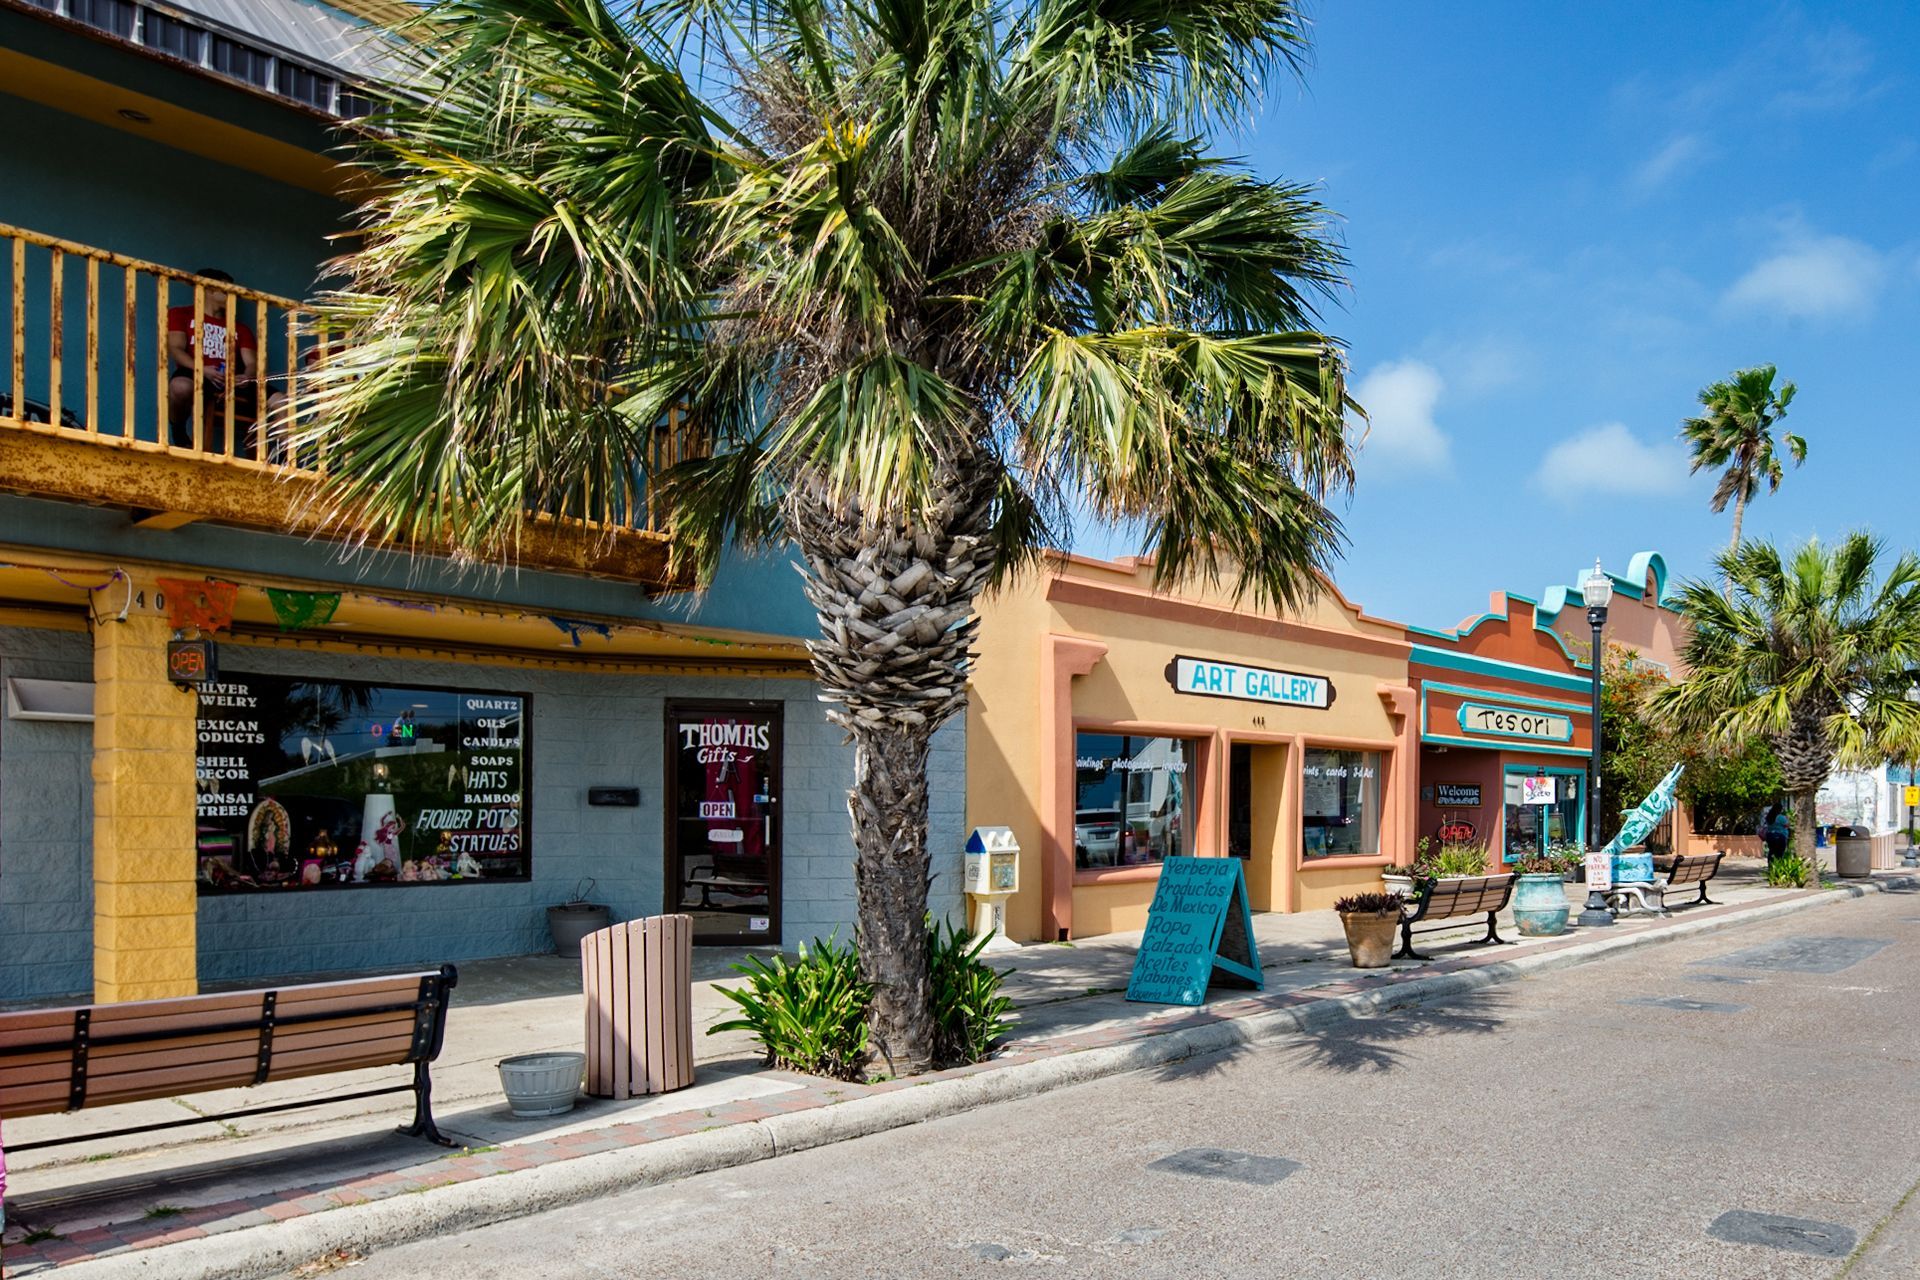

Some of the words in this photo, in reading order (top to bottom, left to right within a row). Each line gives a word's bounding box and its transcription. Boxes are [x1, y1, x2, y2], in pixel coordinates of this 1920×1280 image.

[171, 652, 205, 671] OPEN
[1191, 664, 1236, 693] ART
[1245, 671, 1318, 703] GALLERY
[200, 695, 258, 707] WELRY
[466, 699, 518, 710] QUARTZ
[197, 719, 258, 731] EXICAN
[477, 718, 506, 728] OILS
[1478, 710, 1549, 735] Tesori
[199, 732, 265, 744] ODUCTS
[463, 737, 521, 748] CANDLES
[196, 756, 247, 767] SHELL
[471, 756, 514, 766] SOAPS
[697, 747, 738, 764] Gifts
[196, 769, 249, 780] DECOR
[467, 771, 508, 789] HATS
[464, 794, 521, 804] BAMBOO
[1438, 785, 1480, 796] Welcome
[196, 805, 249, 817] TREES
[703, 803, 733, 817] OPEN
[476, 809, 519, 829] POTS
[449, 834, 520, 852] STATUES
[1168, 858, 1229, 876] Yerberia
[1158, 876, 1227, 897] Productos
[1153, 895, 1169, 912] De
[1170, 896, 1217, 915] Mexico
[1150, 916, 1192, 936] Ropa
[1142, 935, 1203, 955] Calzado
[1136, 953, 1189, 973] Aceites
[1136, 969, 1193, 986] Jabones
